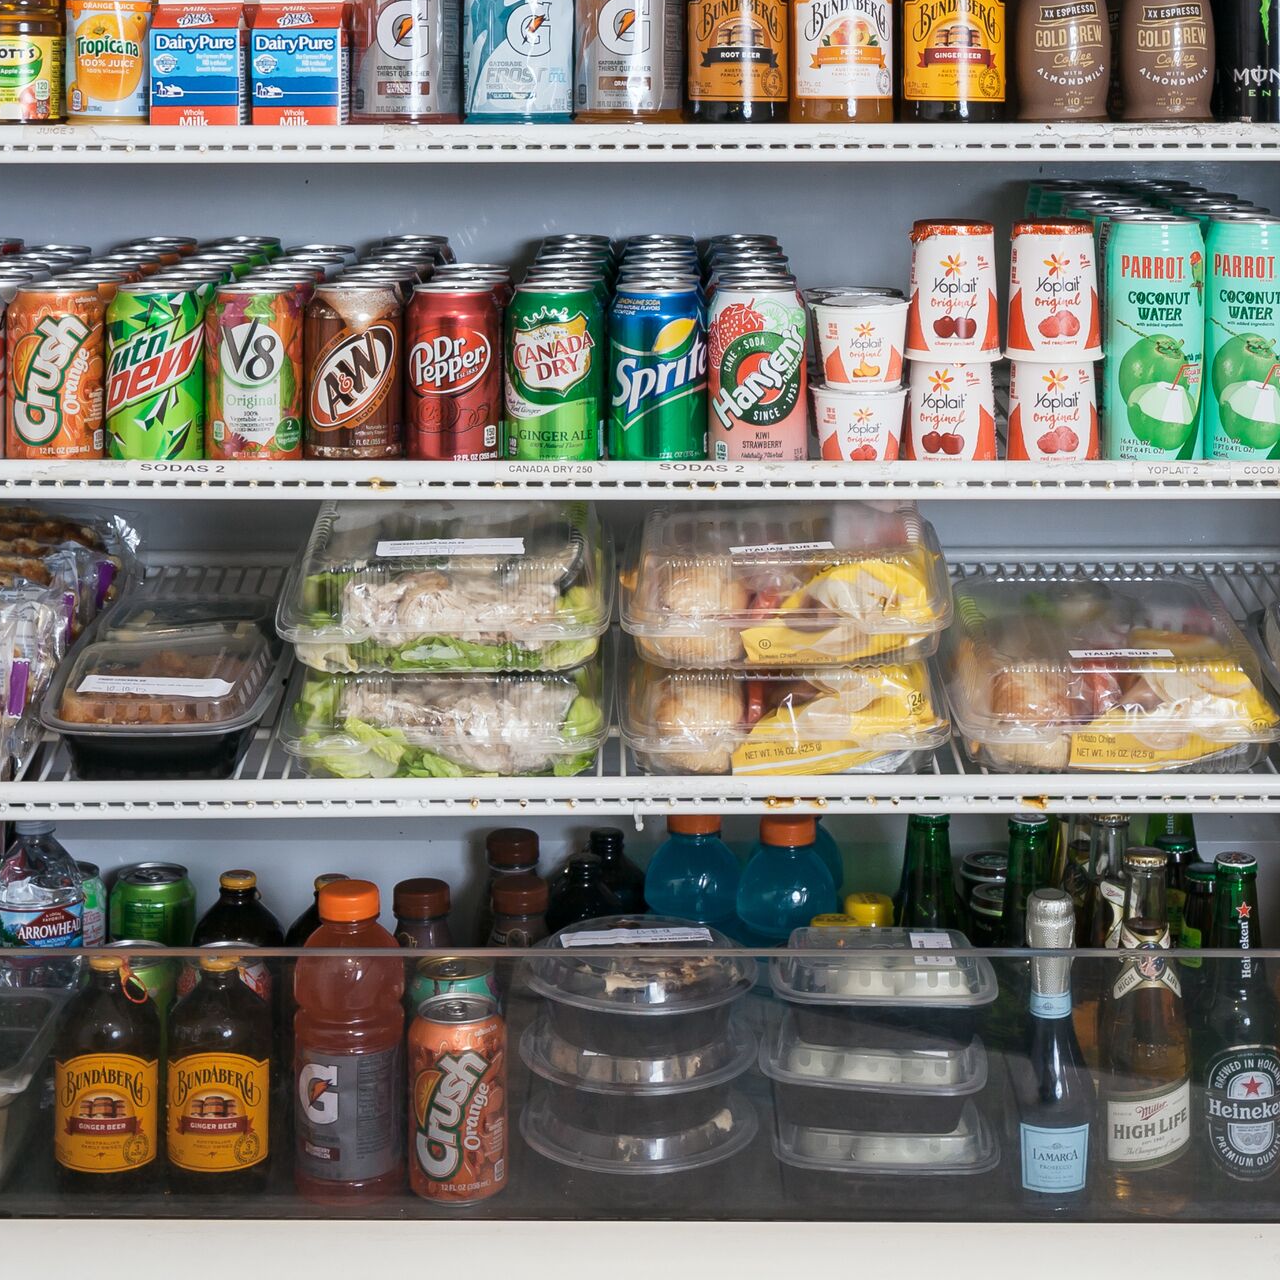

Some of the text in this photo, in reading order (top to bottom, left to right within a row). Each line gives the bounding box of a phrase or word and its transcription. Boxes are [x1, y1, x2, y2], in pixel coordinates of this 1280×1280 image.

[1044, 5, 1095, 18] XX ESPRESSO
[156, 35, 234, 51] DairyPure
[1035, 25, 1102, 48] COLD BREW
[76, 36, 139, 58] Tropicana
[81, 60, 135, 68] 100% JUICE
[37, 127, 66, 135] JUICE
[1121, 255, 1184, 280] PARROT
[932, 276, 978, 296] Yoplait
[1035, 276, 1081, 296] Yoplait
[1128, 291, 1191, 306] COCONUT
[1138, 307, 1183, 321] WATER
[221, 317, 276, 381] V8
[433, 336, 466, 356] Dr
[513, 330, 596, 371] CANADA
[724, 336, 766, 373] SODA CANE
[414, 341, 485, 387] Pepper
[536, 355, 580, 382] DRY
[14, 315, 90, 445] Crush
[63, 348, 90, 415] Orange
[322, 331, 382, 422] A&W
[611, 338, 708, 420] Sprite
[713, 325, 806, 429] Hansen's
[226, 393, 277, 409] Original
[520, 429, 593, 442] GINGER ALE
[742, 440, 782, 449] STRAWBERRY
[755, 431, 770, 439] KIWI
[141, 463, 225, 473] SODAS 2
[508, 465, 593, 473] CANADA DRY 250
[659, 463, 745, 472] SODAS 2
[1148, 466, 1199, 475] YOPLAIT 2
[1244, 466, 1275, 475] COCO
[1077, 734, 1116, 745] Potato Chips
[19, 919, 81, 939] ARROWHEAD
[1117, 974, 1179, 992] HIGH LIFE
[61, 1065, 150, 1108] BUNDABERG
[417, 1050, 491, 1179] Crush
[464, 1082, 490, 1151] Orange
[1114, 1107, 1188, 1140] HIGH LIFE
[78, 1122, 126, 1131] GINGER BEER
[1033, 1143, 1079, 1161] LAMARCA
